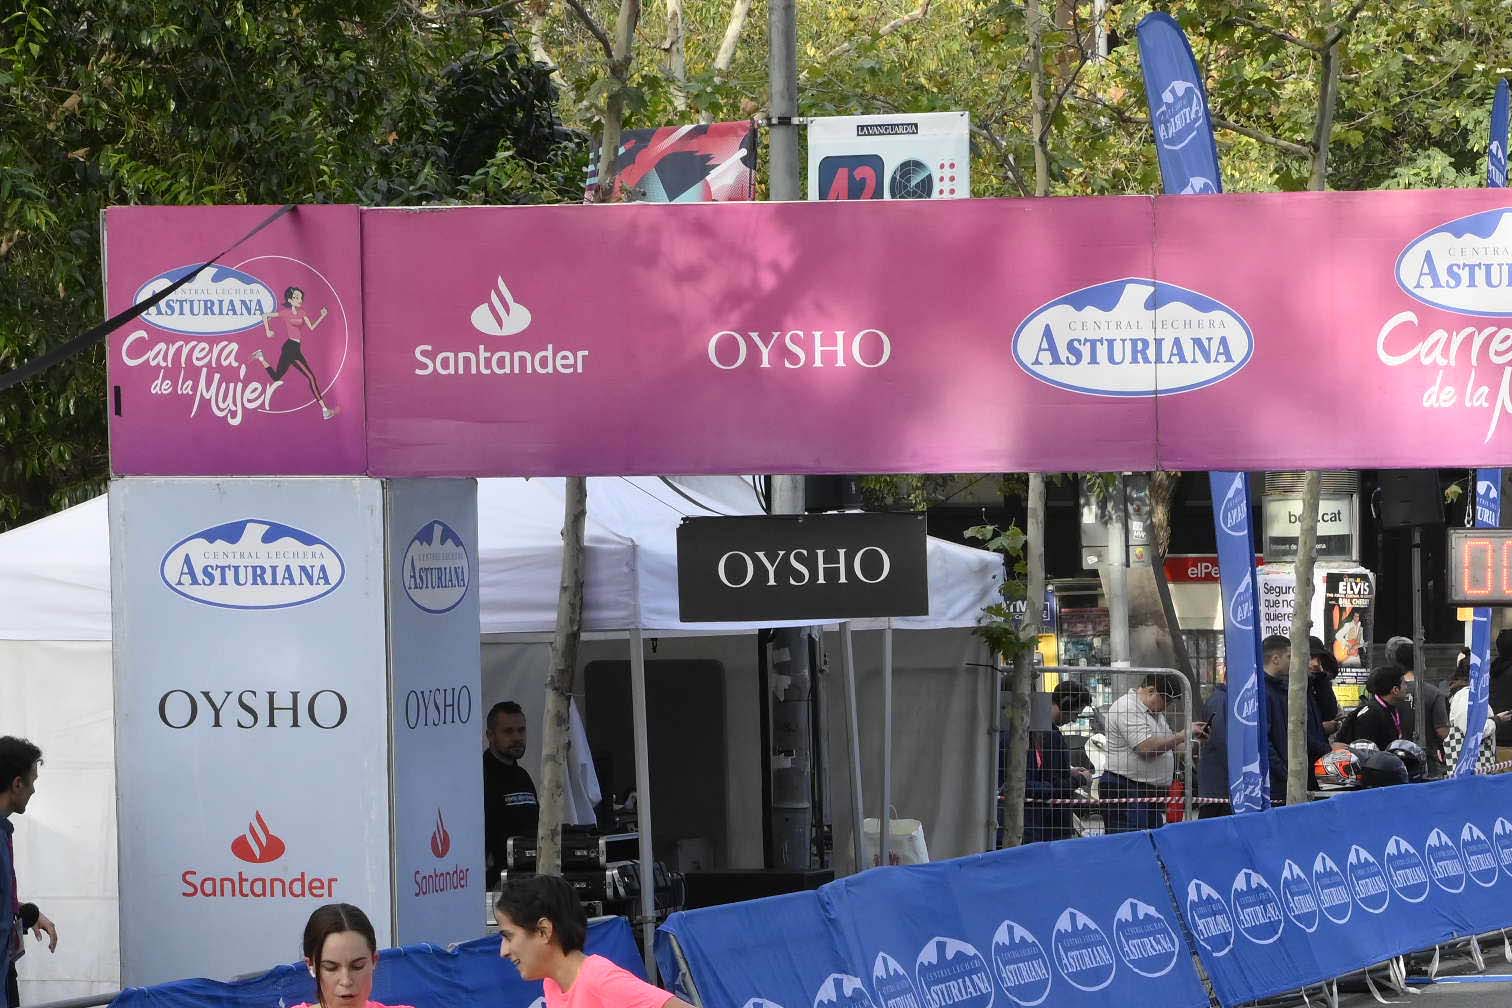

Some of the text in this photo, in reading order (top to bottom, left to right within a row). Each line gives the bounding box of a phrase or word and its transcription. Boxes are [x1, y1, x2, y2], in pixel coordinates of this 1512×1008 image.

[868, 124, 917, 135] VANGUARDIA
[1068, 318, 1228, 331] CENTRAL LECHERA
[121, 330, 240, 367] Carrera
[414, 344, 589, 376] Santander
[707, 329, 892, 370] OYSHO
[1031, 322, 1235, 367] ASTURIANA
[151, 364, 284, 426] de la Mujer
[1422, 369, 1457, 409] de
[1464, 369, 1490, 409] la
[175, 553, 332, 586] ASTURIANA
[203, 550, 324, 560] CENTRAL LECHERA
[718, 546, 890, 588] OYSHO
[408, 557, 465, 591] ASTURIANA
[1339, 581, 1369, 595] ELVIS
[1265, 599, 1280, 609] que
[159, 690, 347, 729] OYSHO
[405, 685, 471, 730] OYSHO
[181, 871, 338, 898] Santander
[415, 866, 470, 898] Santander
[996, 956, 1049, 987] ASTURIANA
[1058, 942, 1113, 973] ASTURIANA
